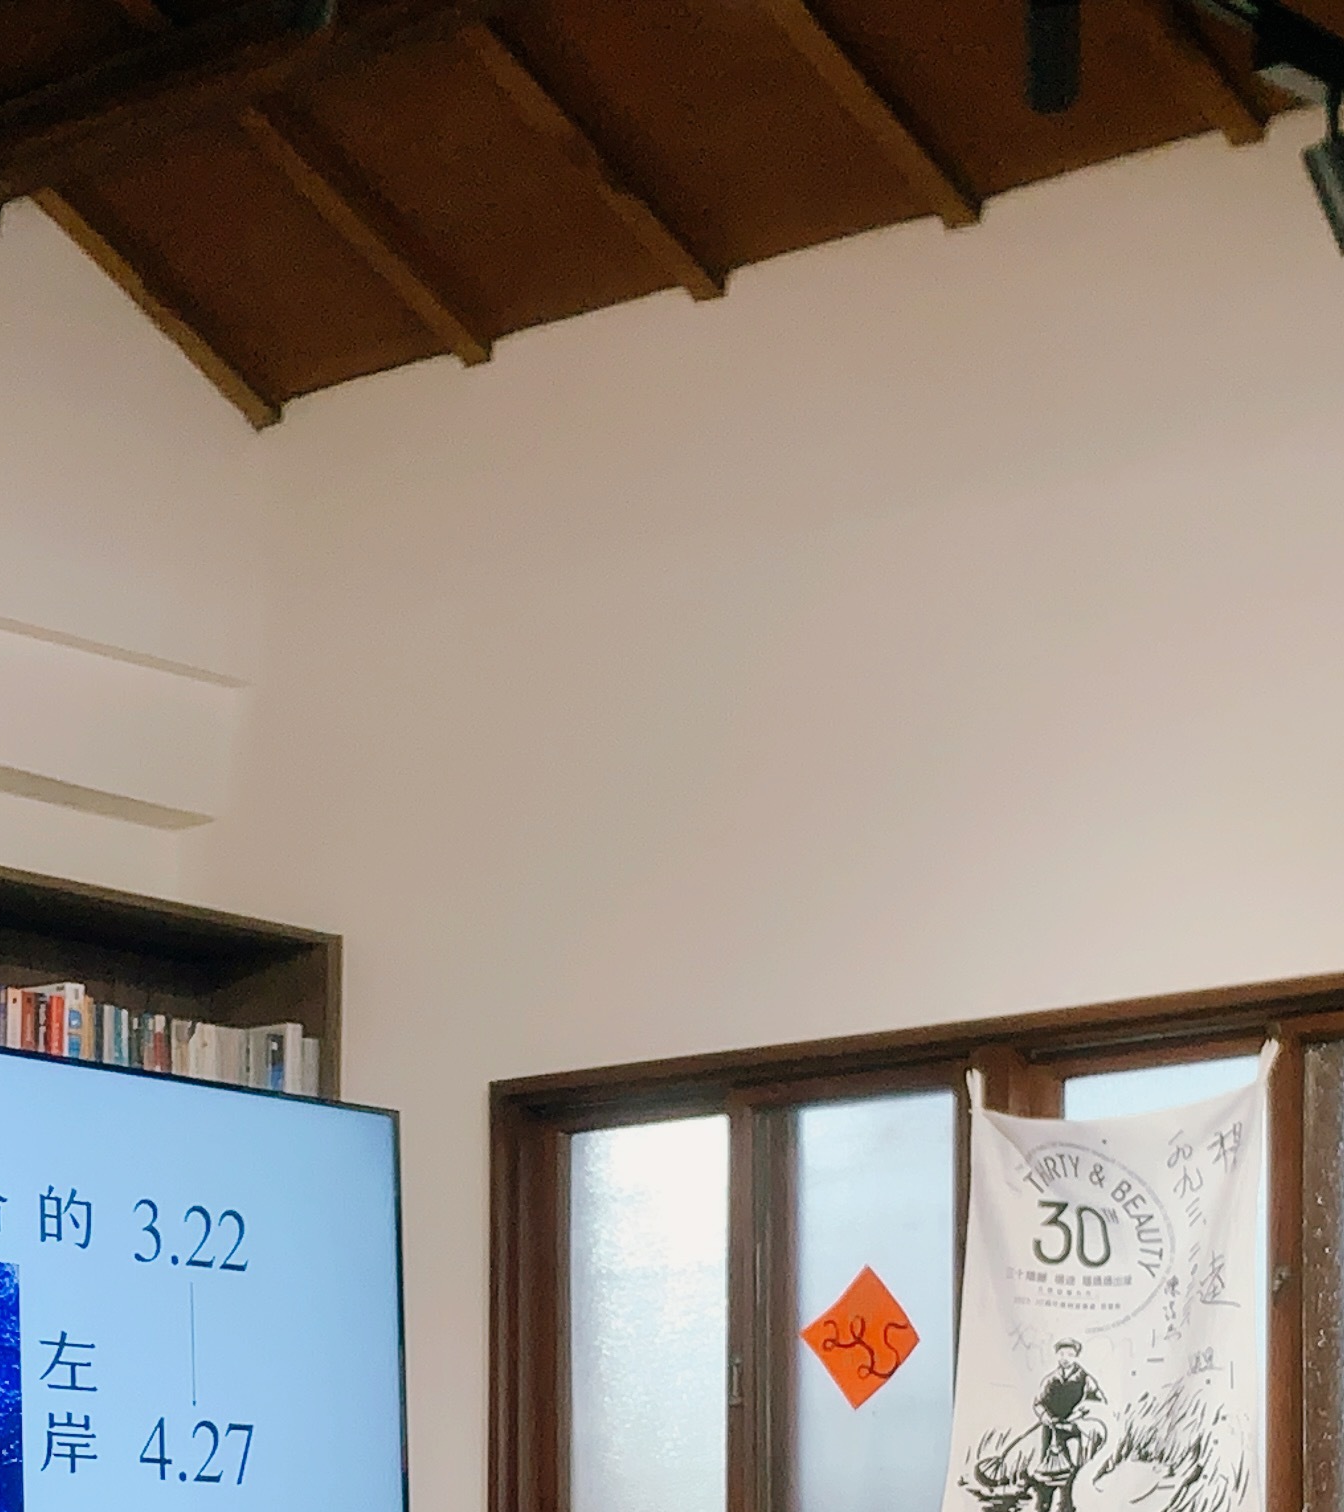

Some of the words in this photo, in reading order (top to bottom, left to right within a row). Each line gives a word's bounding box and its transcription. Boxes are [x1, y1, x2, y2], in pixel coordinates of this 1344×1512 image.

[132, 1198, 249, 1273] 3.22
[1110, 1179, 1164, 1279] BEAUTY
[39, 1331, 99, 1475] 左岸
[138, 1417, 254, 1486] 4.27
